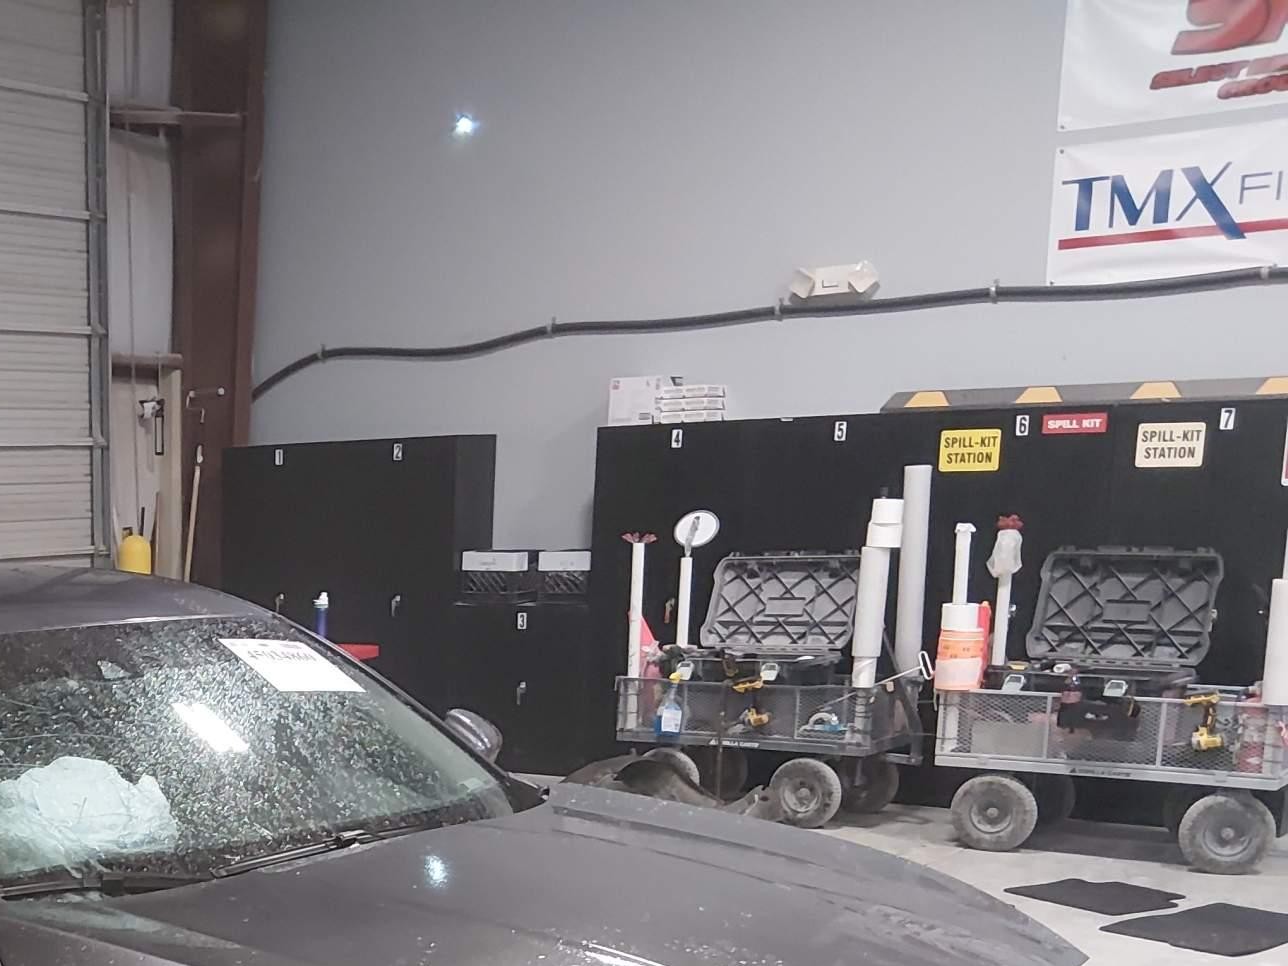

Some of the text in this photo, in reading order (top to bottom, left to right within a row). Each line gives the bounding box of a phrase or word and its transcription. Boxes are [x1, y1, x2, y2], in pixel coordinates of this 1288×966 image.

[1062, 161, 1247, 240] TMX
[1018, 416, 1027, 434] 6
[1047, 418, 1103, 429] SPILL KIT
[1223, 409, 1233, 428] 7
[836, 422, 845, 439] 5
[1142, 429, 1202, 443] SPILL-KIT
[673, 431, 681, 447] 4
[944, 435, 999, 449] SPILL-KIT
[395, 445, 402, 459] 2
[946, 451, 993, 465] STATION
[1144, 446, 1196, 460] STATION
[519, 614, 525, 628] 3
